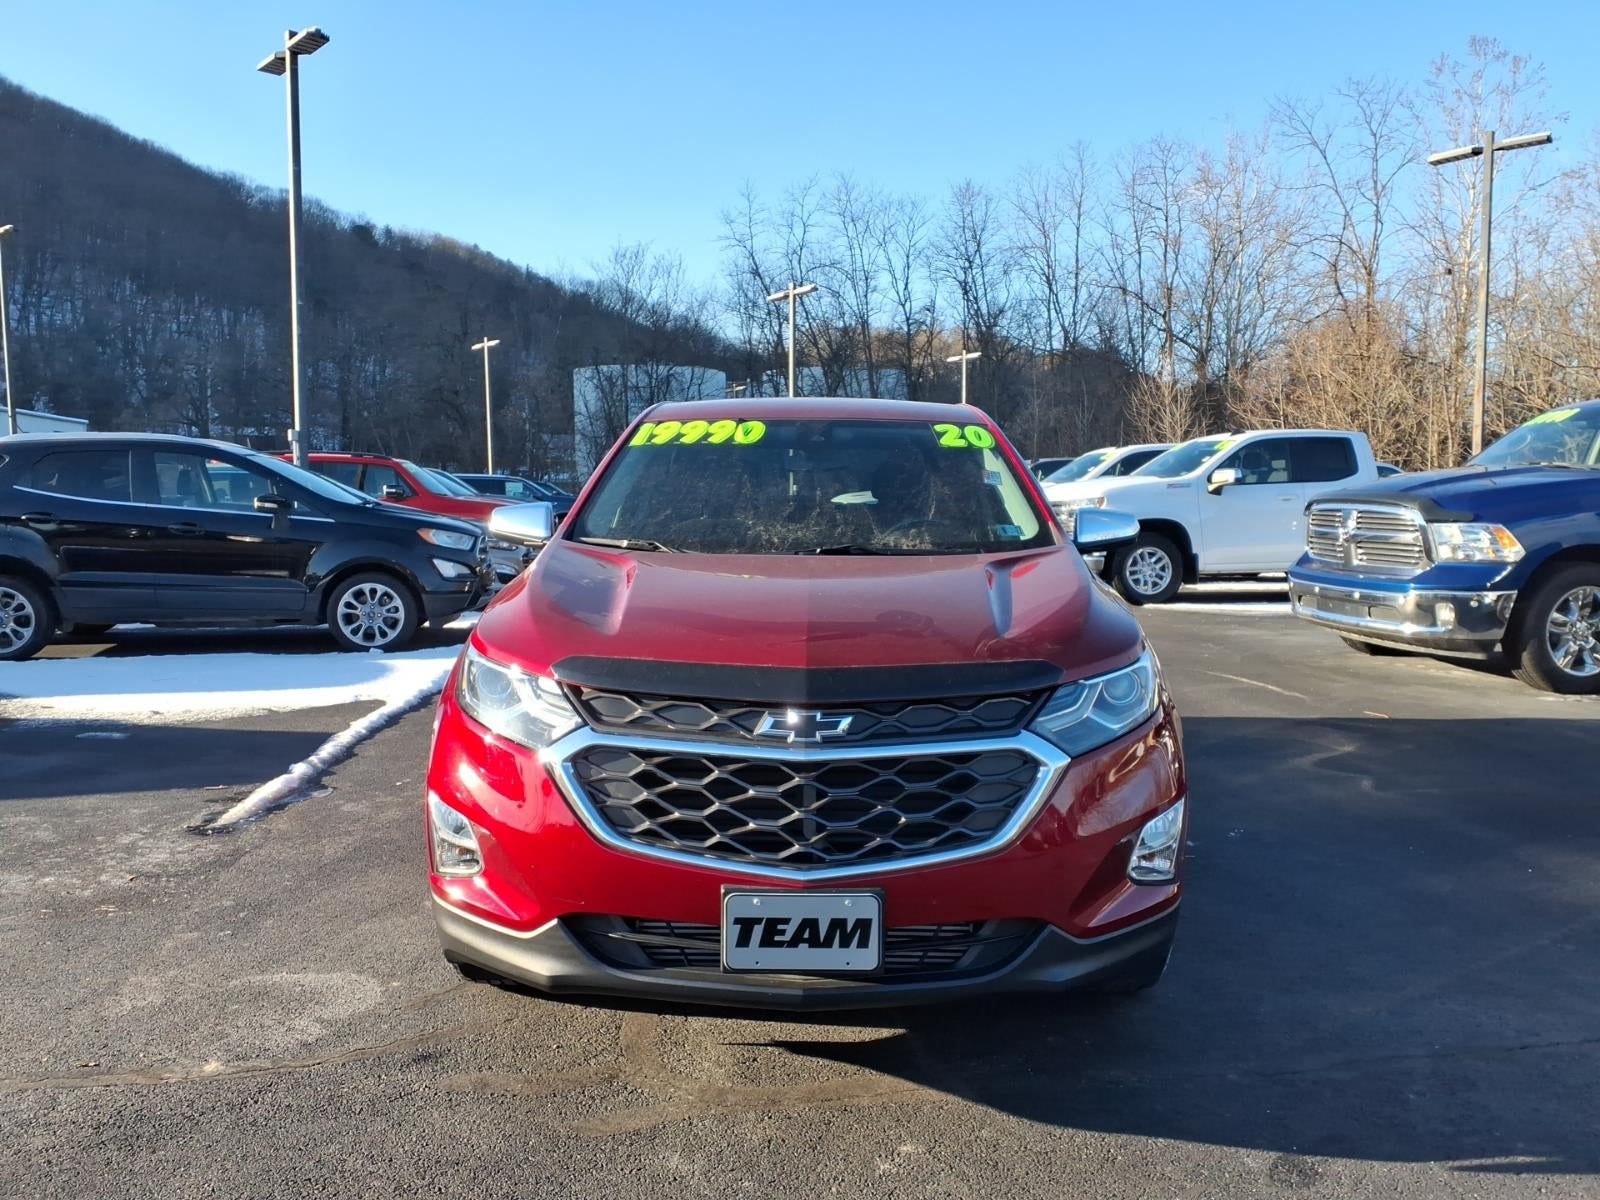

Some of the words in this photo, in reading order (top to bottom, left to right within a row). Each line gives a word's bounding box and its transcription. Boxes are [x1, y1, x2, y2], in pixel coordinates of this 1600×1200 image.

[629, 420, 766, 446] 19990
[933, 424, 995, 448] 20
[733, 917, 872, 949] TEAM
